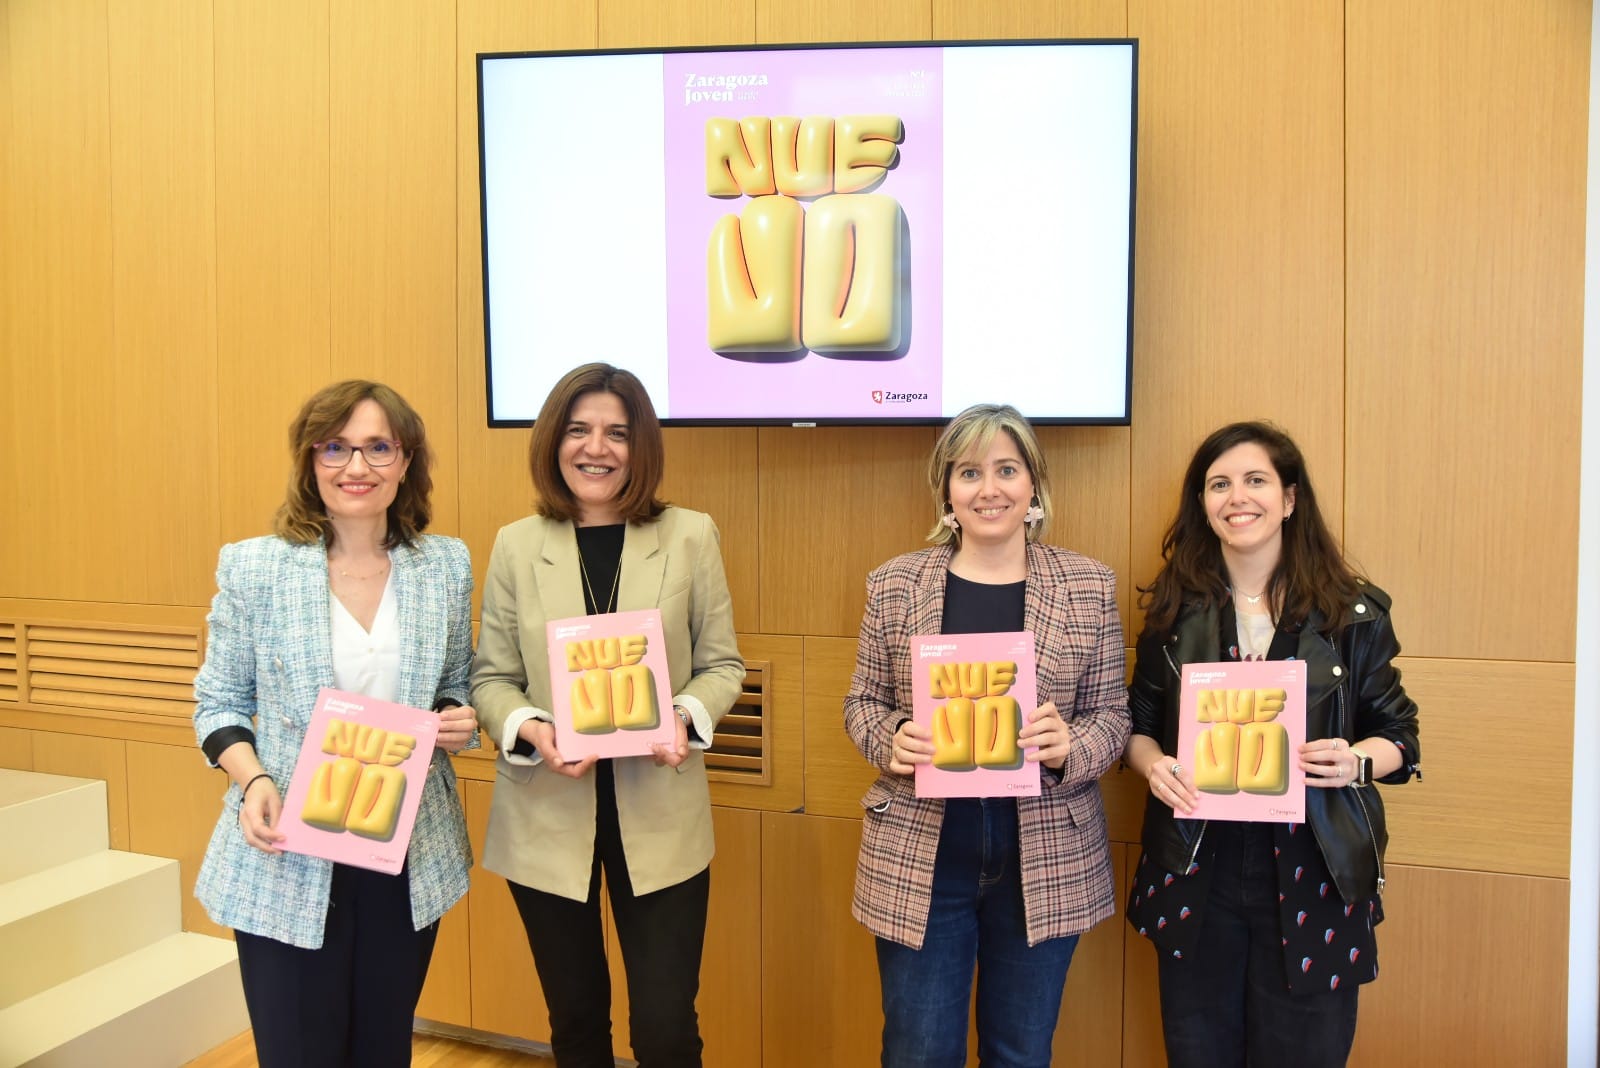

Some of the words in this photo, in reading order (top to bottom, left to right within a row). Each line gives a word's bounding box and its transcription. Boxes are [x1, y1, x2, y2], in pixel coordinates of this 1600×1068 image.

[684, 72, 768, 90] Zaragoza
[705, 115, 904, 197] NUE
[885, 392, 928, 402] Zaragoza
[565, 634, 648, 672] NUE
[929, 661, 1017, 699] NUE
[1197, 688, 1287, 724] NUE
[321, 718, 416, 766] NUE
